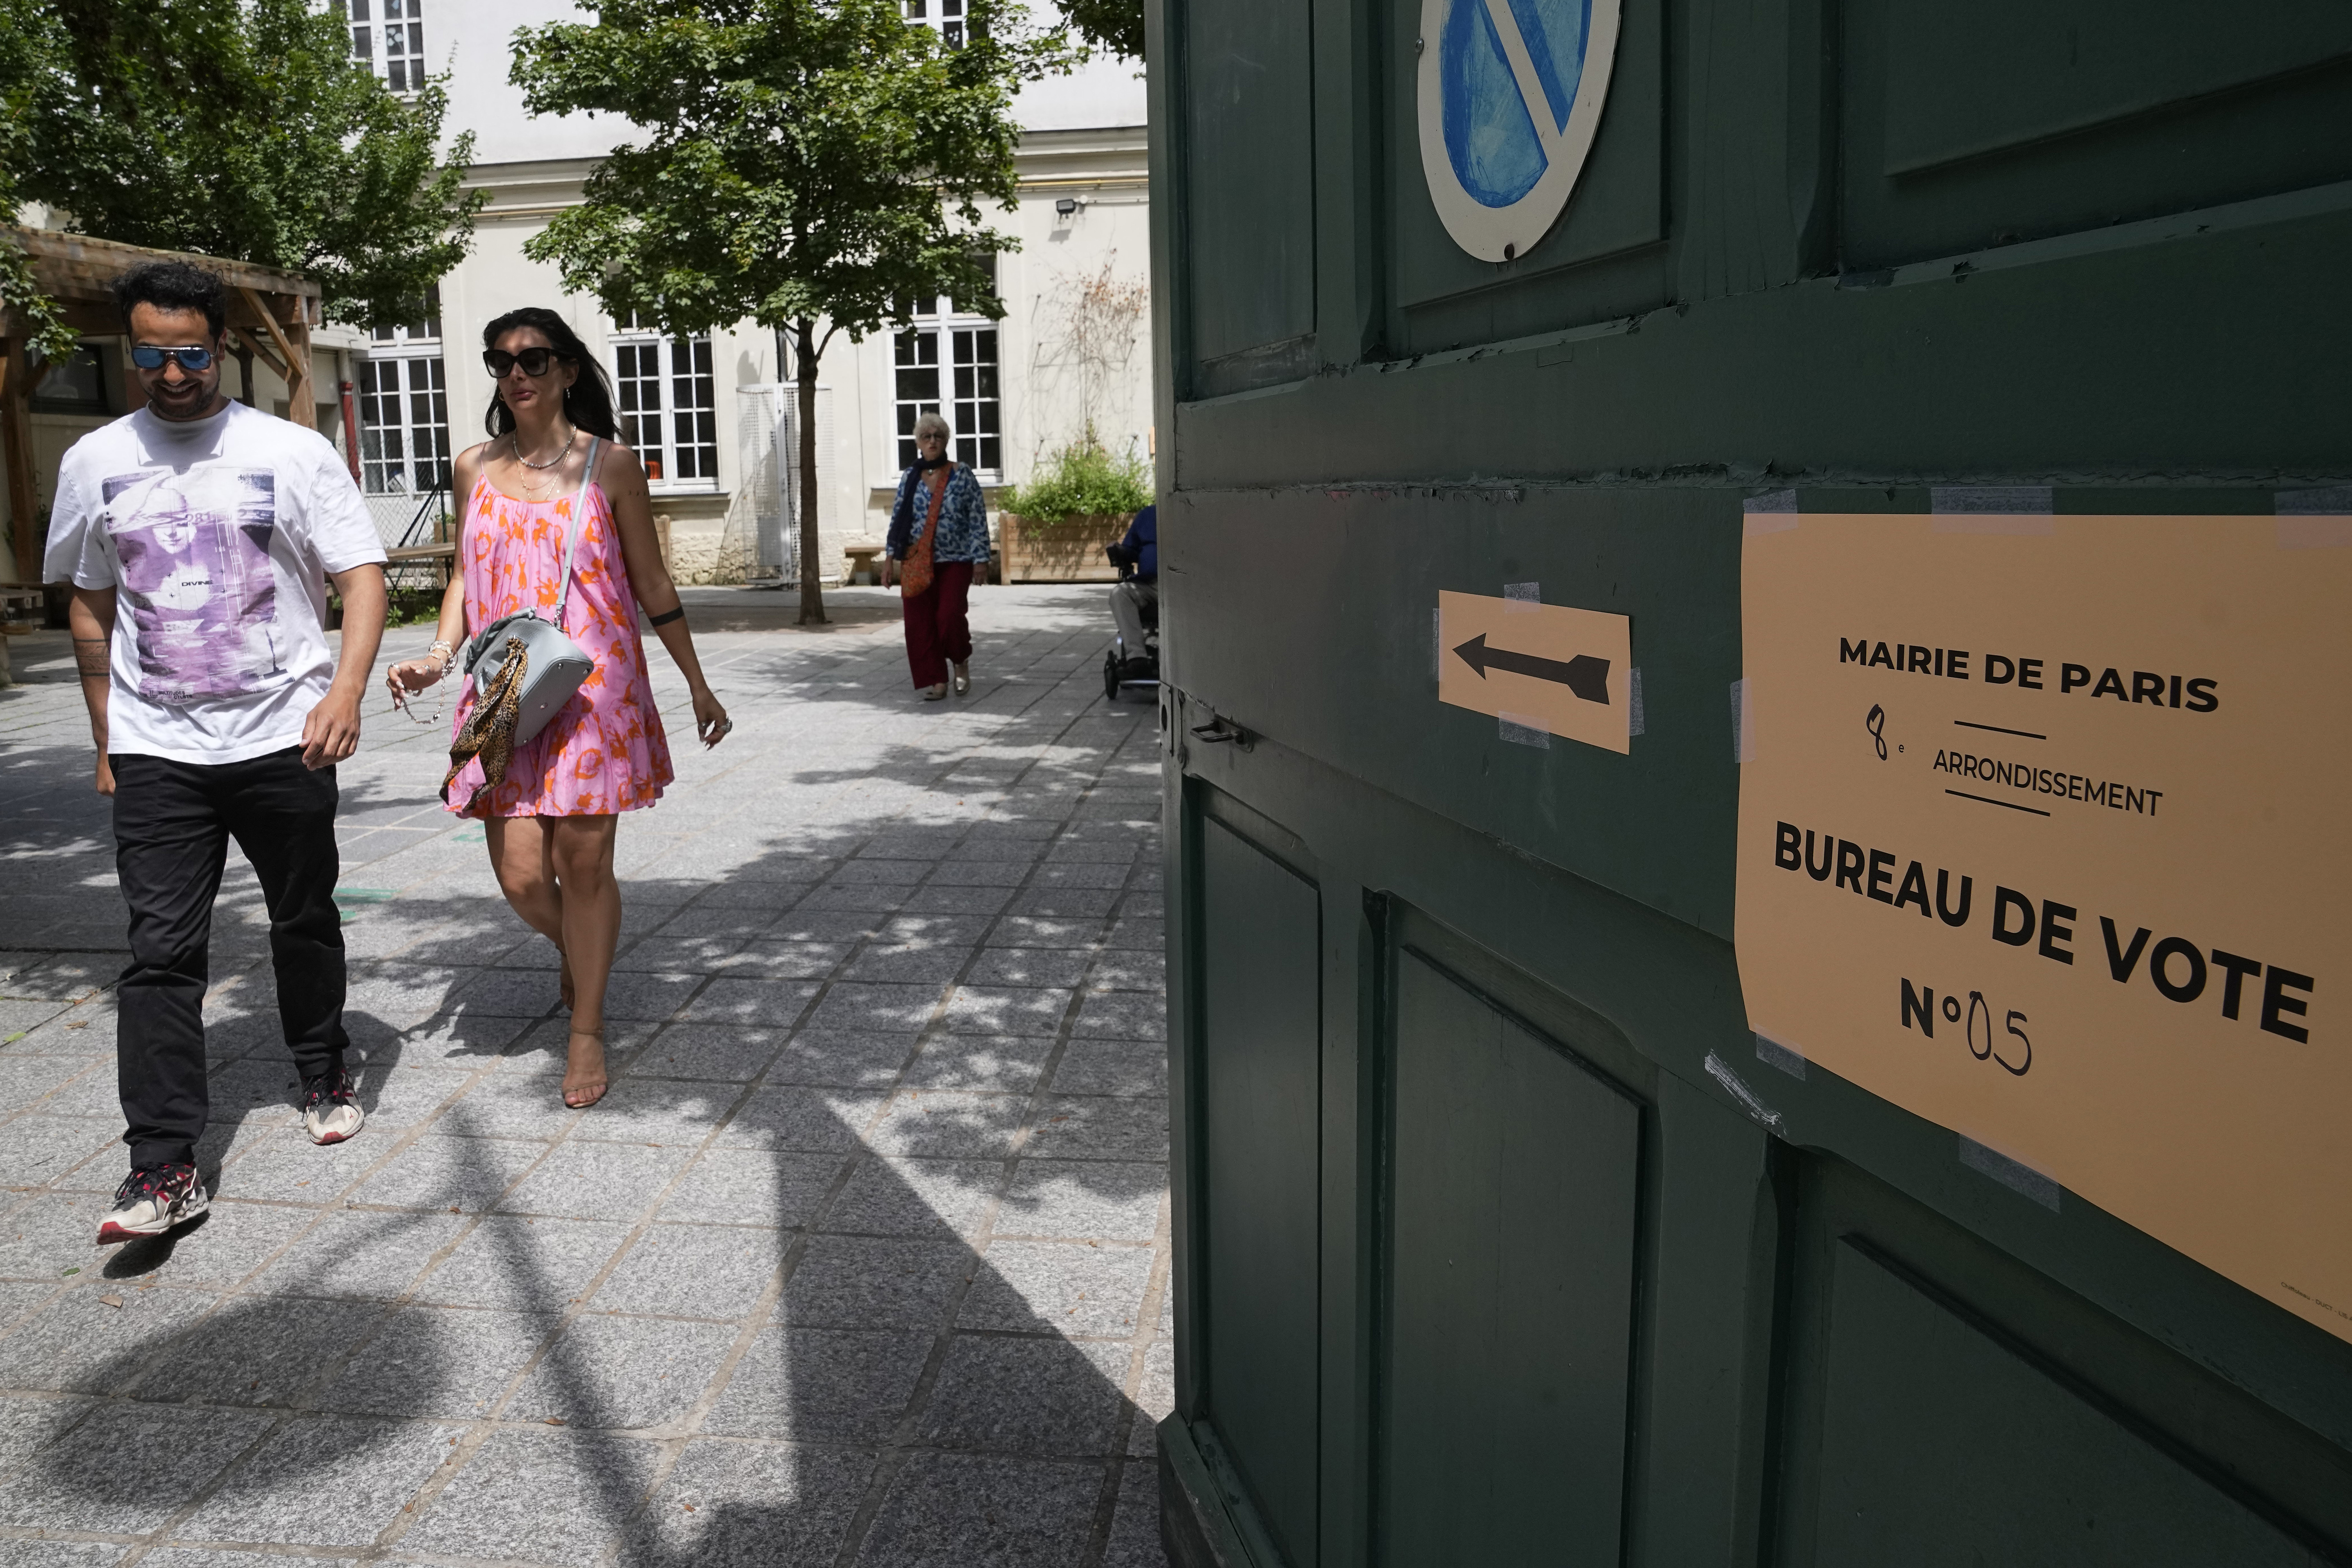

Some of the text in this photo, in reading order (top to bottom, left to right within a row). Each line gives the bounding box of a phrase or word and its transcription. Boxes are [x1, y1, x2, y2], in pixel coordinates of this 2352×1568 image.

[1839, 637, 2219, 713] MAIRIE DE PARIS
[1933, 749, 2163, 817] ARRONDISSEMENT
[1775, 820, 2315, 1045] BUREAU DE VOTE
